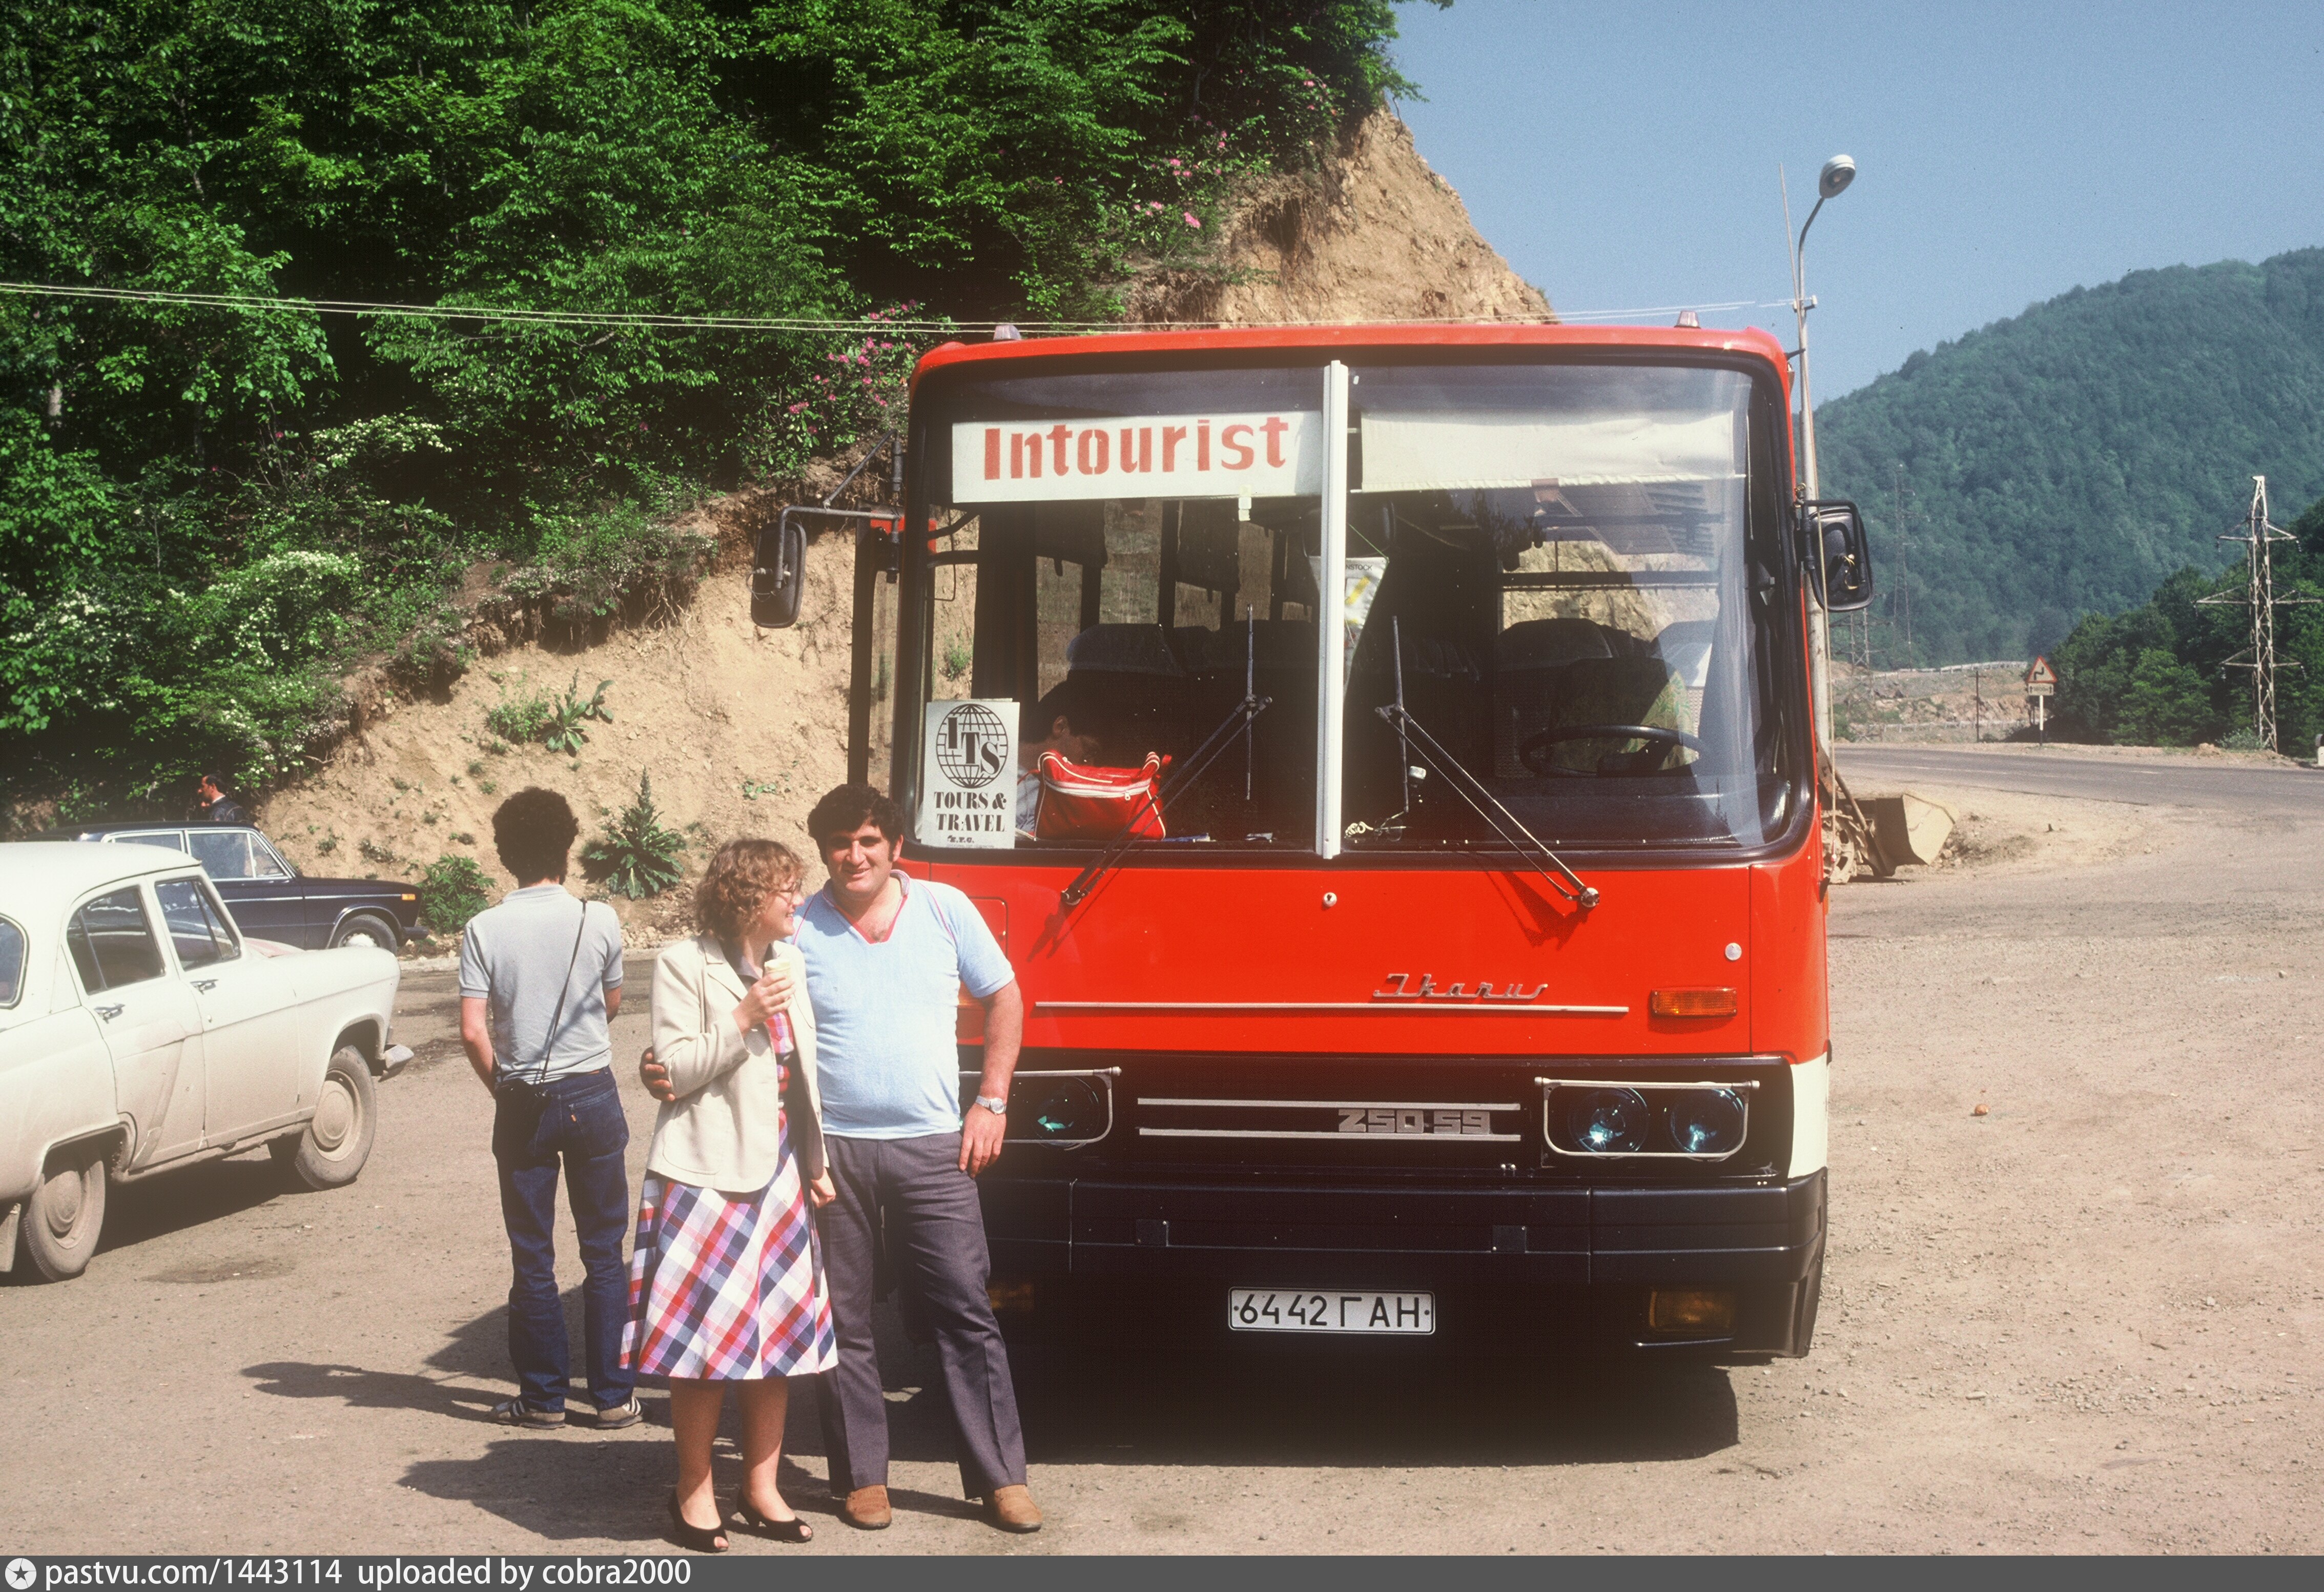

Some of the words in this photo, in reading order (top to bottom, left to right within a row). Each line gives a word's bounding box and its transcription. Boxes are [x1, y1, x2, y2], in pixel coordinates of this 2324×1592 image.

[984, 416, 1289, 480] Intourist
[948, 717, 1000, 775] ITS
[934, 791, 989, 809] TOURS
[992, 792, 1007, 810] &
[937, 813, 1005, 832] TRAVEL
[1373, 973, 1548, 998] Ikarus
